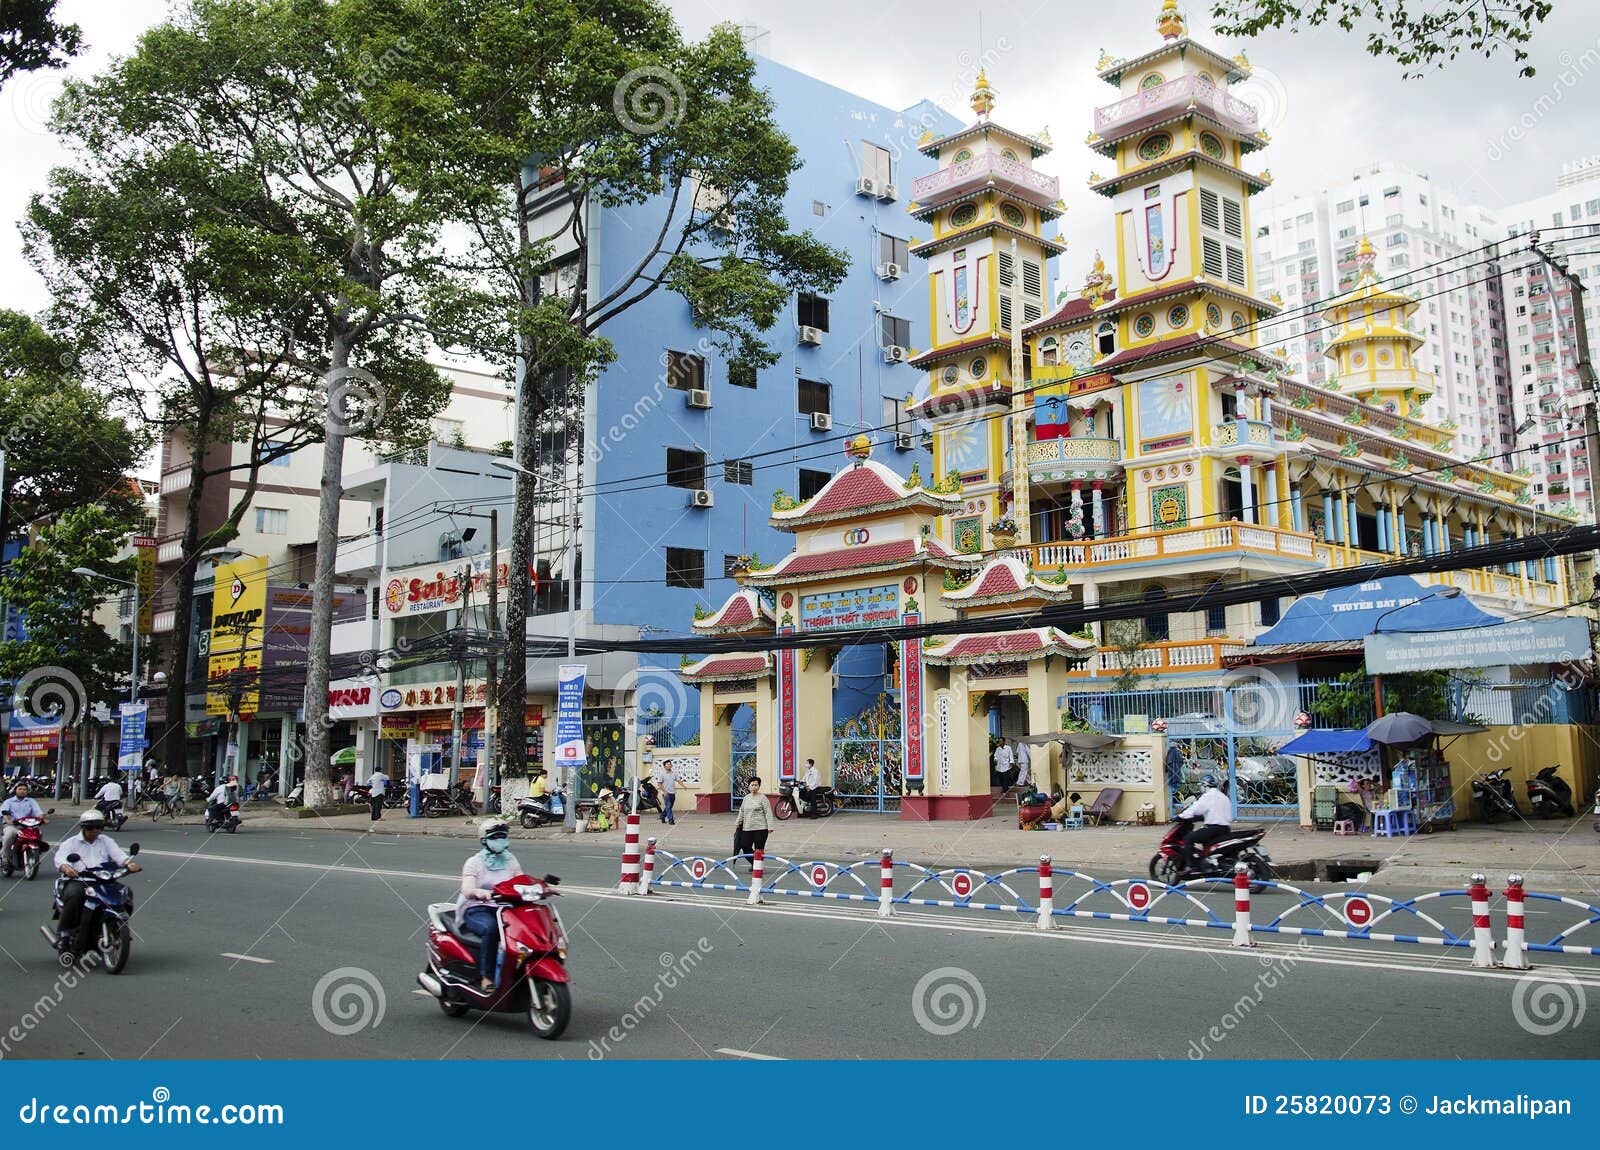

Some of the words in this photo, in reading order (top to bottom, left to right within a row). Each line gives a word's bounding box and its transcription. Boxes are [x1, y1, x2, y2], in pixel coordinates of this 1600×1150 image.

[134, 538, 156, 546] HOTEL
[409, 601, 444, 612] RESTAURANT
[213, 608, 263, 629] DUNLOP
[804, 615, 834, 628] THÁNH
